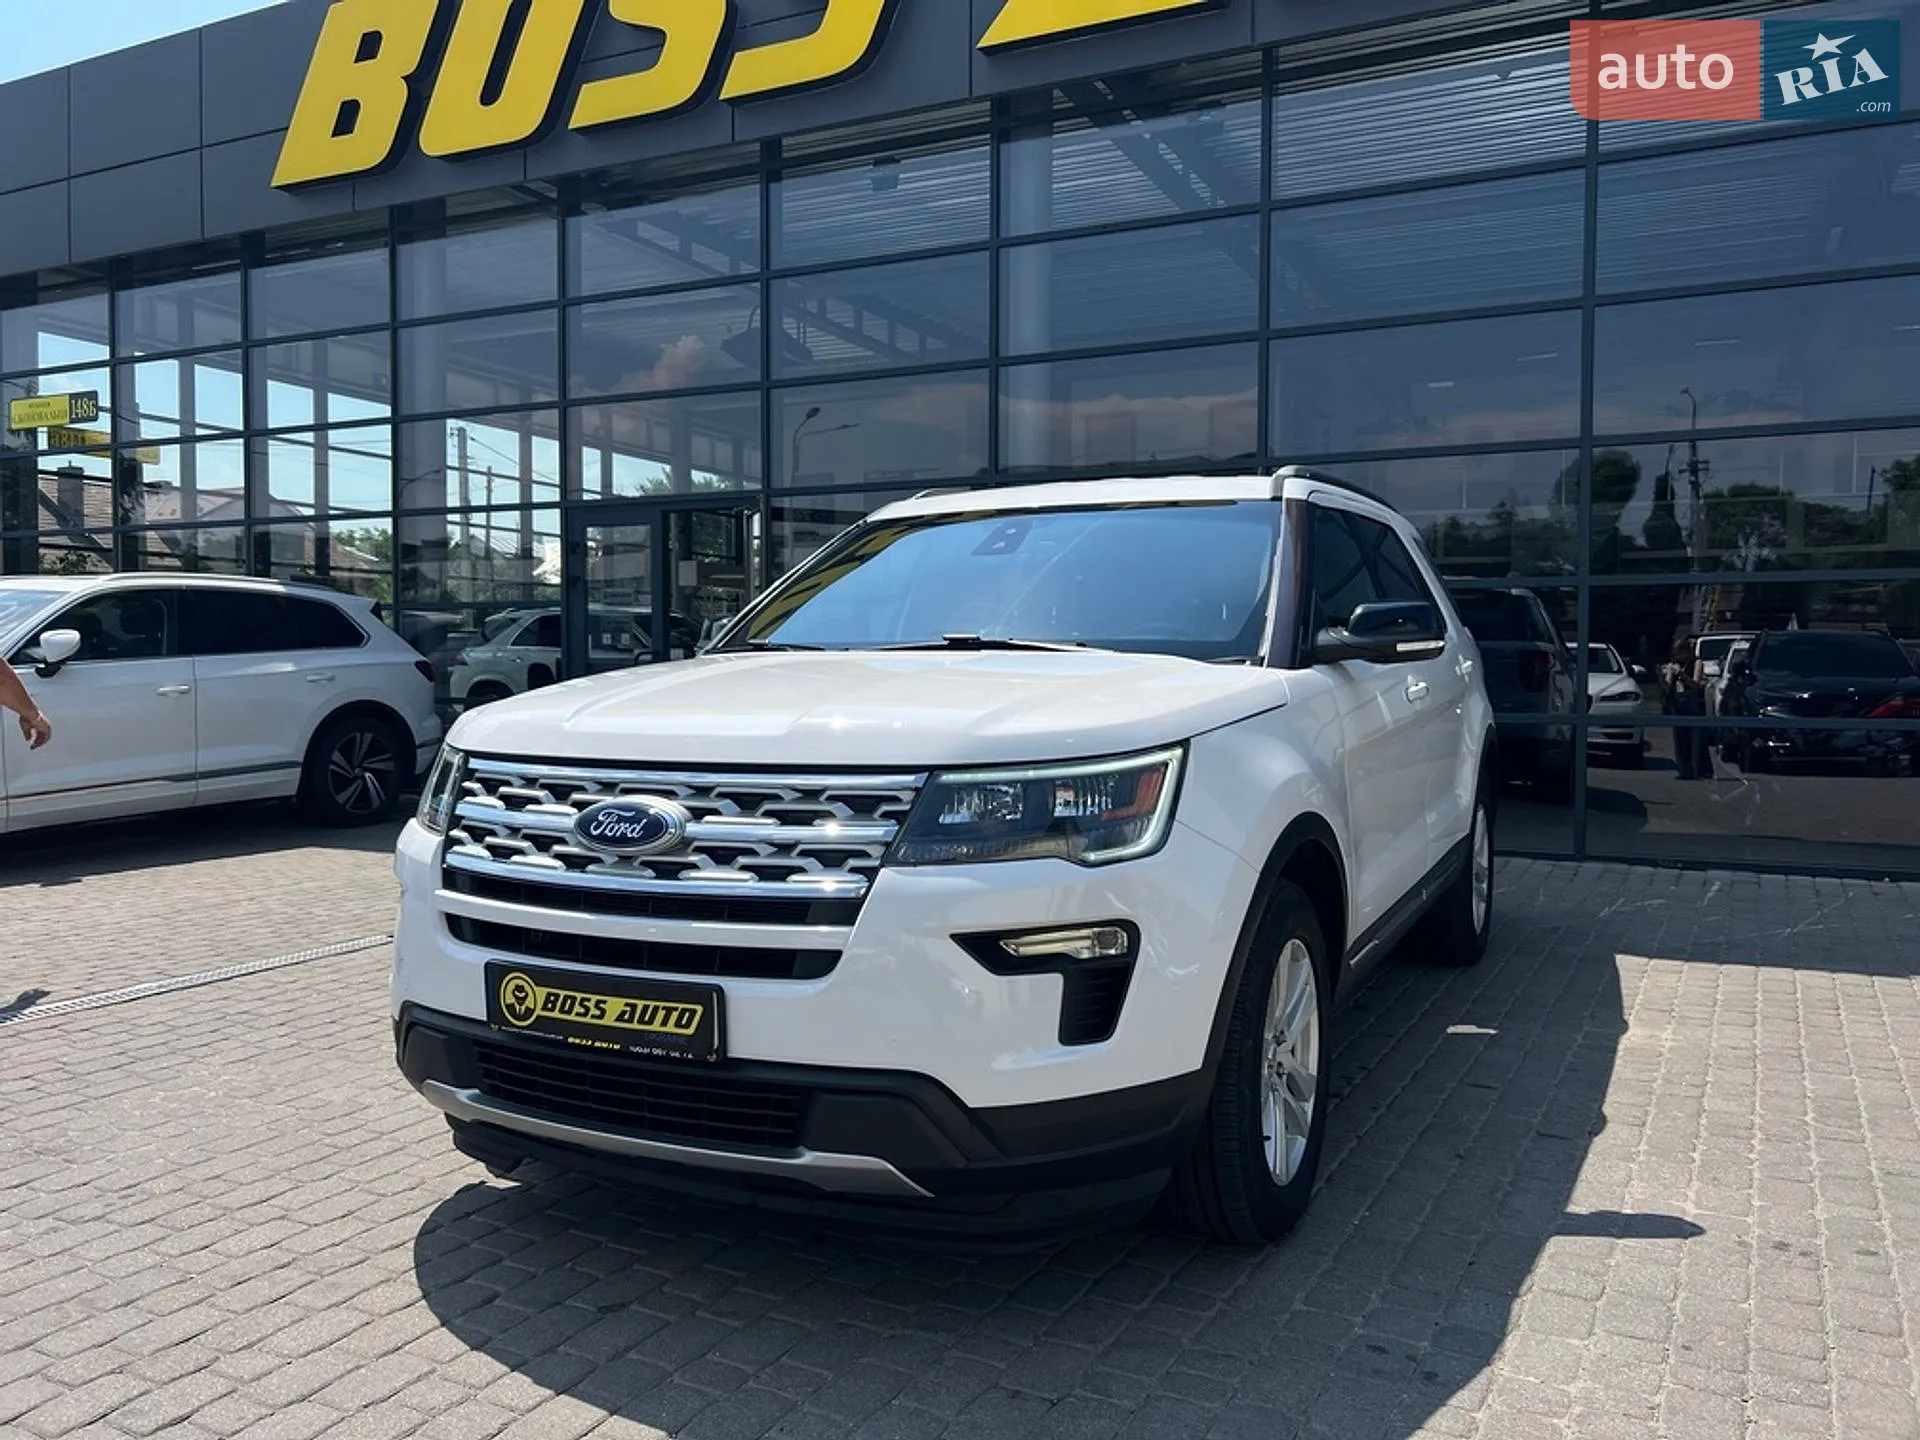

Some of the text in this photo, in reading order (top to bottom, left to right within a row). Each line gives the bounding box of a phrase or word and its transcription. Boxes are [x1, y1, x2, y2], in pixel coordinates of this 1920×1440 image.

[590, 808, 648, 838] Ford
[541, 991, 698, 1030] BOSS AUTO
